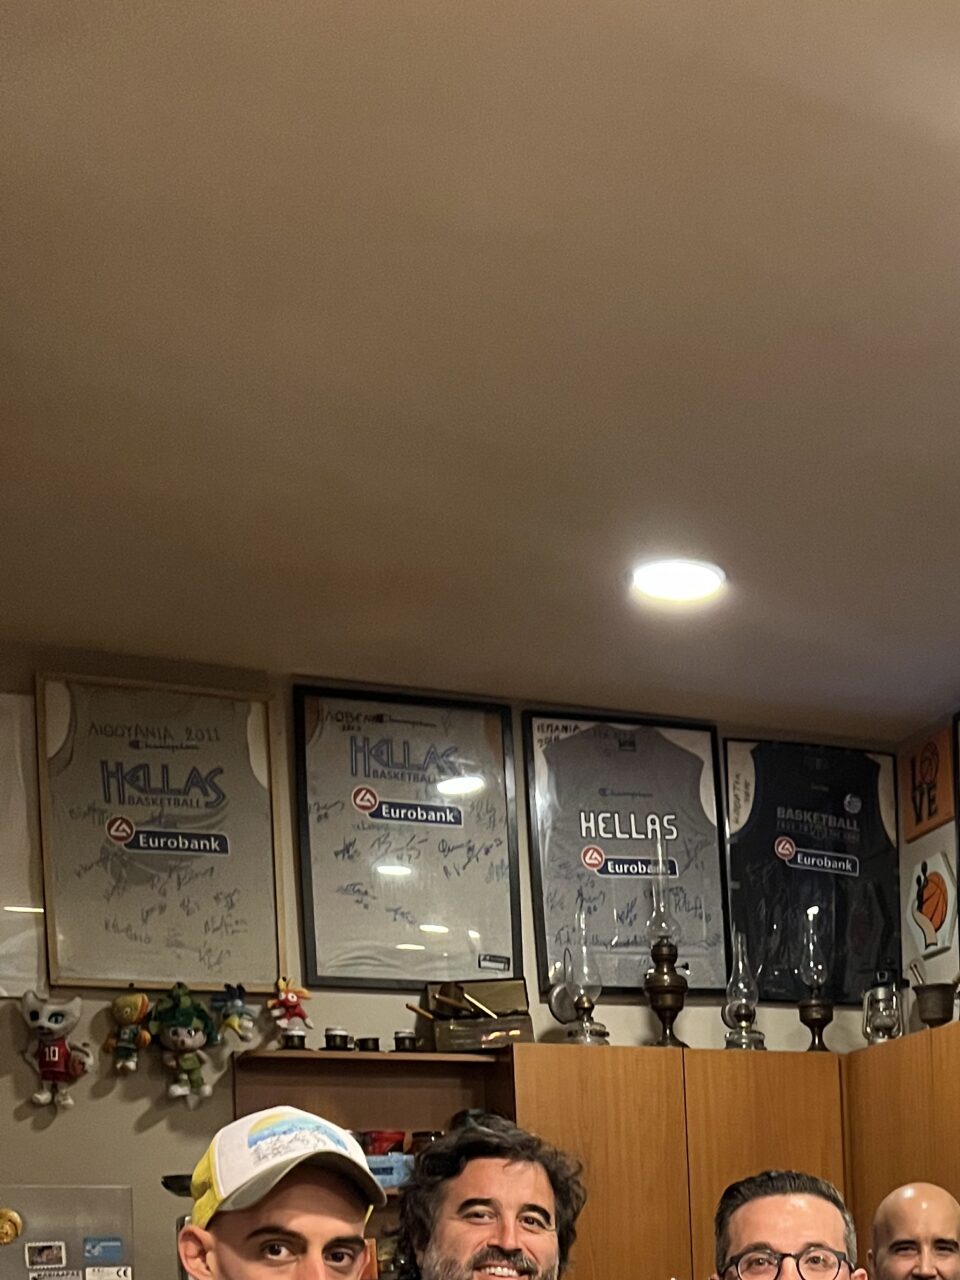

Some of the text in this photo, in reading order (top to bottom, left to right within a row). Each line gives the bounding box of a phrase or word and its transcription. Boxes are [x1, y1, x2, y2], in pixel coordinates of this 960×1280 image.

[101, 760, 226, 809] HELLAS
[381, 803, 455, 823] Eurobank
[776, 805, 860, 832] BASKETBALL
[579, 811, 678, 841] HELLAS
[139, 834, 221, 852] Eurobank
[607, 860, 671, 875] Euroba
[796, 853, 853, 872] Eurobank
[44, 1046, 59, 1062] 10
